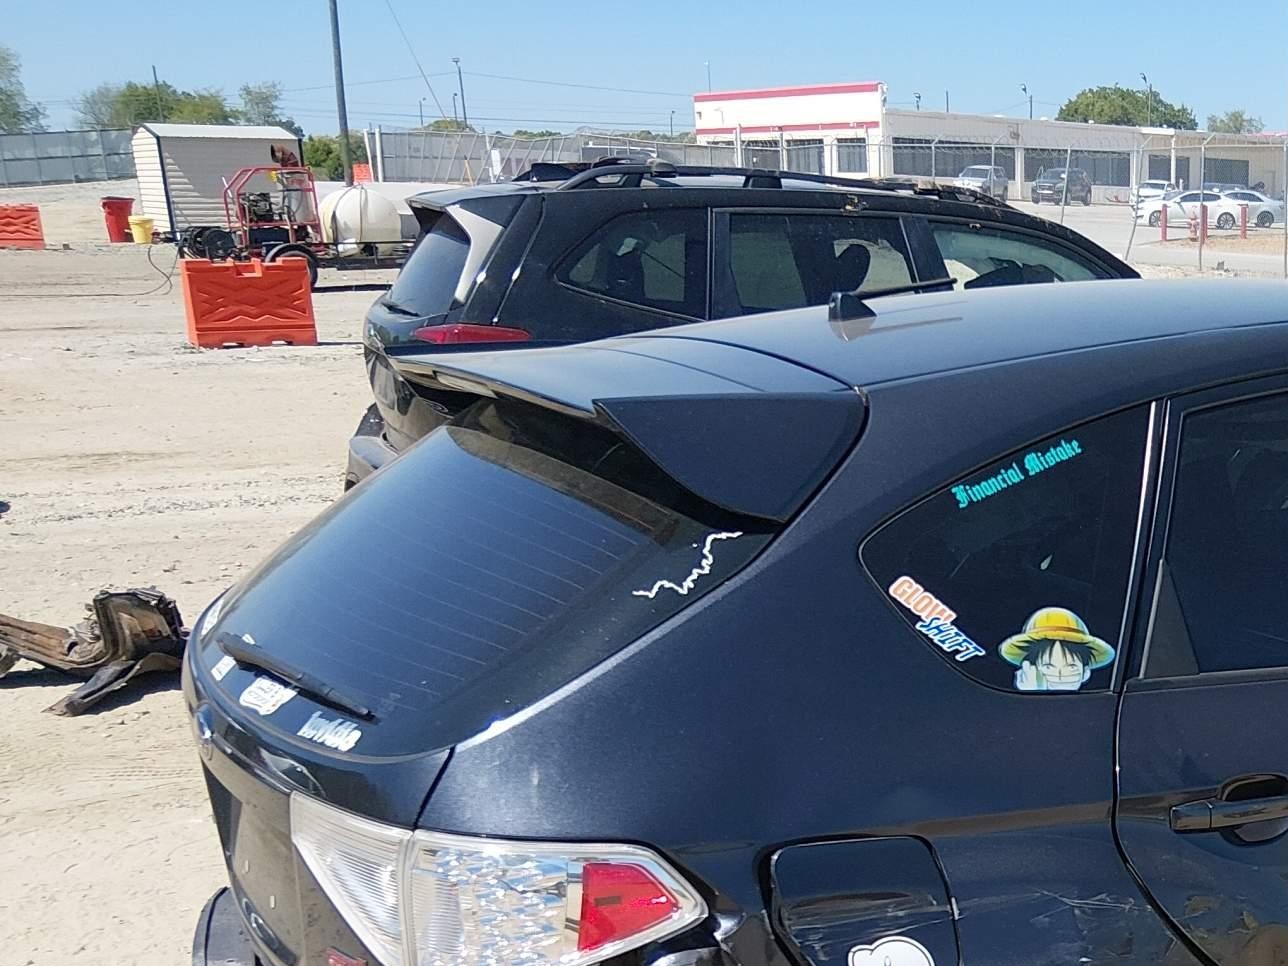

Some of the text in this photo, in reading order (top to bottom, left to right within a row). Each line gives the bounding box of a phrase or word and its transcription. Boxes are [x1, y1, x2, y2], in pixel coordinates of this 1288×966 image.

[951, 439, 1082, 509] Financial Mistake
[890, 577, 956, 624] GLOW
[917, 616, 985, 661] SHIFT
